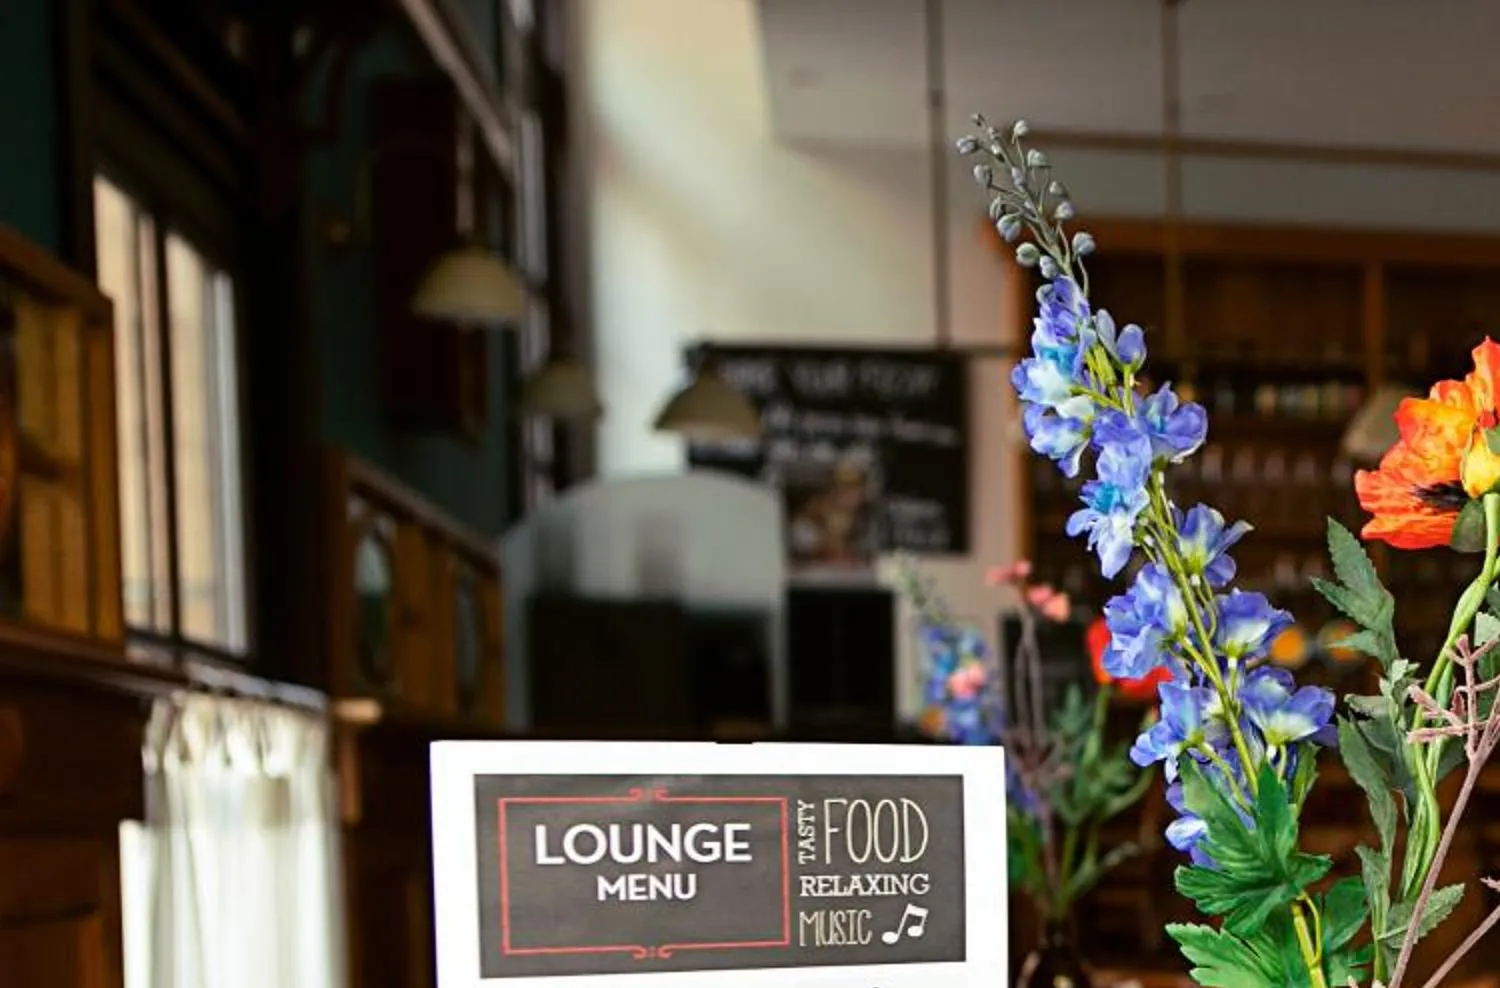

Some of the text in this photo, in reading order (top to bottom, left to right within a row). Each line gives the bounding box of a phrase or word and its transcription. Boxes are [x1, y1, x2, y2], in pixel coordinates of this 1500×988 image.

[535, 822, 752, 865] LOUNGE
[798, 798, 929, 865] TASTY FOOD
[597, 872, 697, 901] MENU
[799, 872, 931, 897] RELAXING
[799, 908, 873, 947] MUSIC
